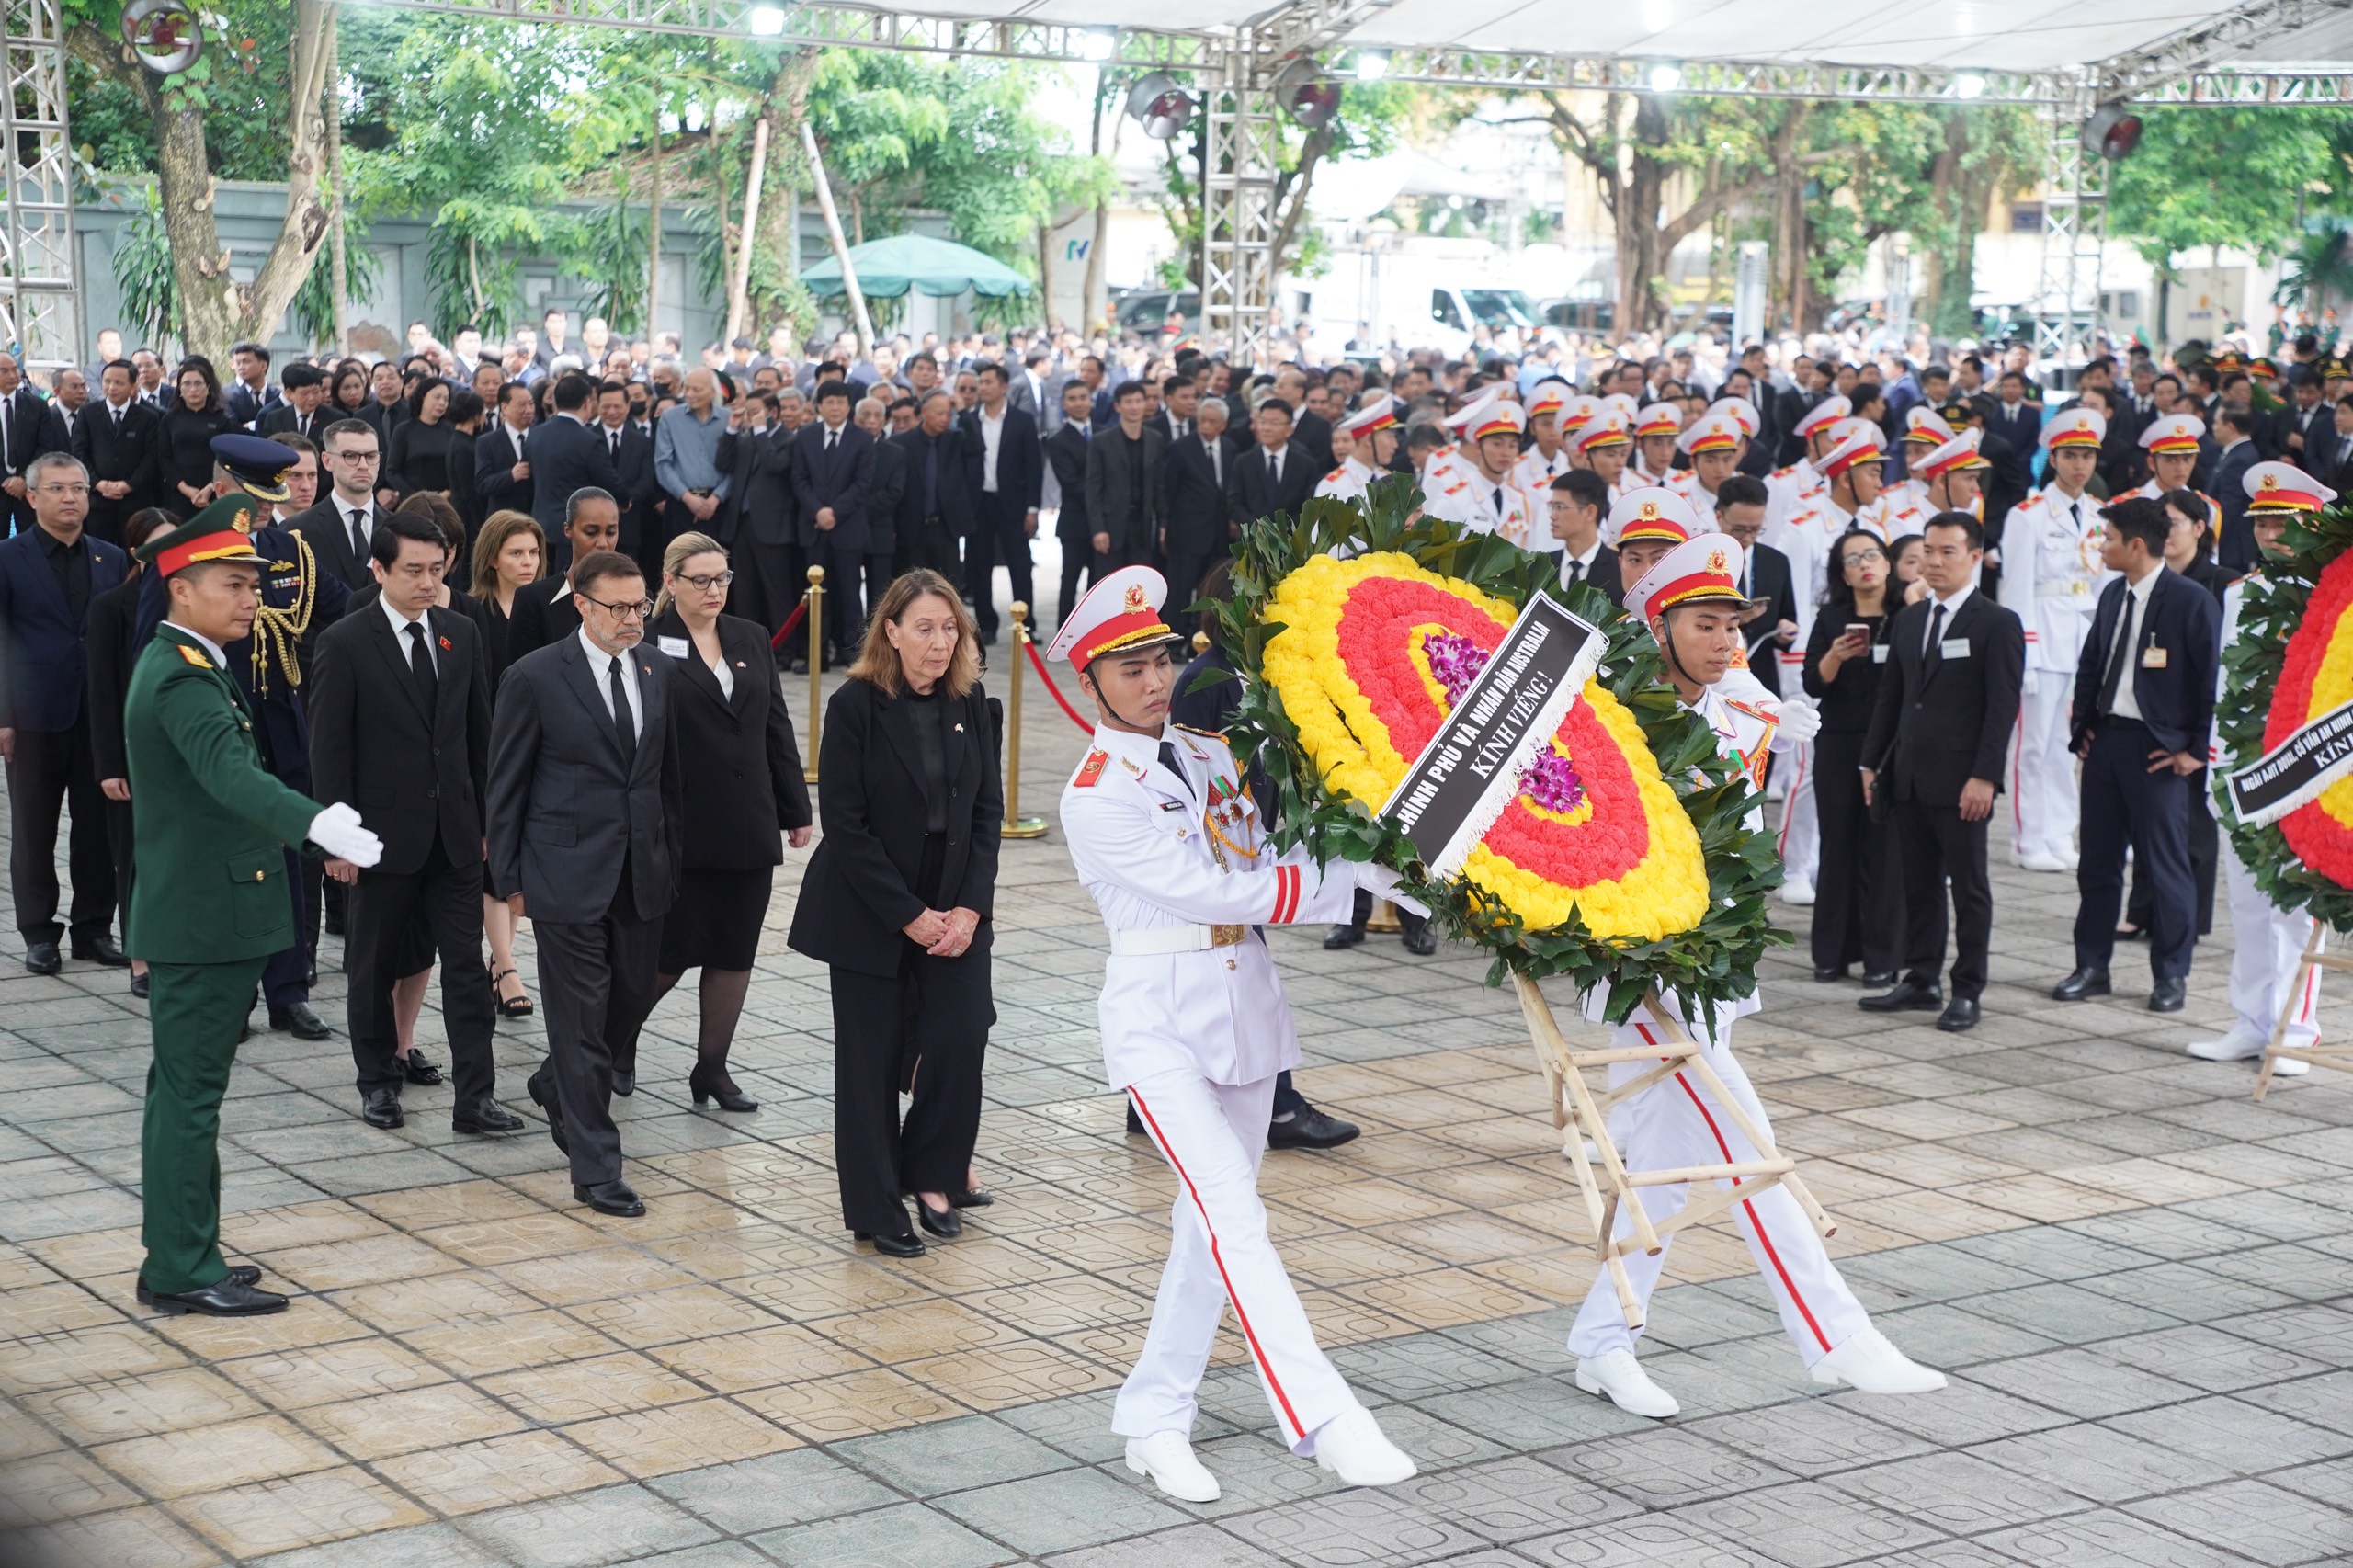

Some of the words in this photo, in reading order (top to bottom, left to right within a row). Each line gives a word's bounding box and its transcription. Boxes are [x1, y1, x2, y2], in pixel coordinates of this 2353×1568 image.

[1506, 620, 1551, 674] AUSTRALIA
[1493, 666, 1520, 695] DÂN
[1468, 686, 1506, 727] NHÂN
[1452, 722, 1481, 747] VÀ
[1469, 722, 1518, 780] KÍNH
[1506, 676, 1549, 728] VIẾNG
[2261, 762, 2279, 783] AJIT
[2318, 722, 2334, 742] AN
[2329, 712, 2353, 734] NINH
[1427, 743, 1463, 783] PHỦ
